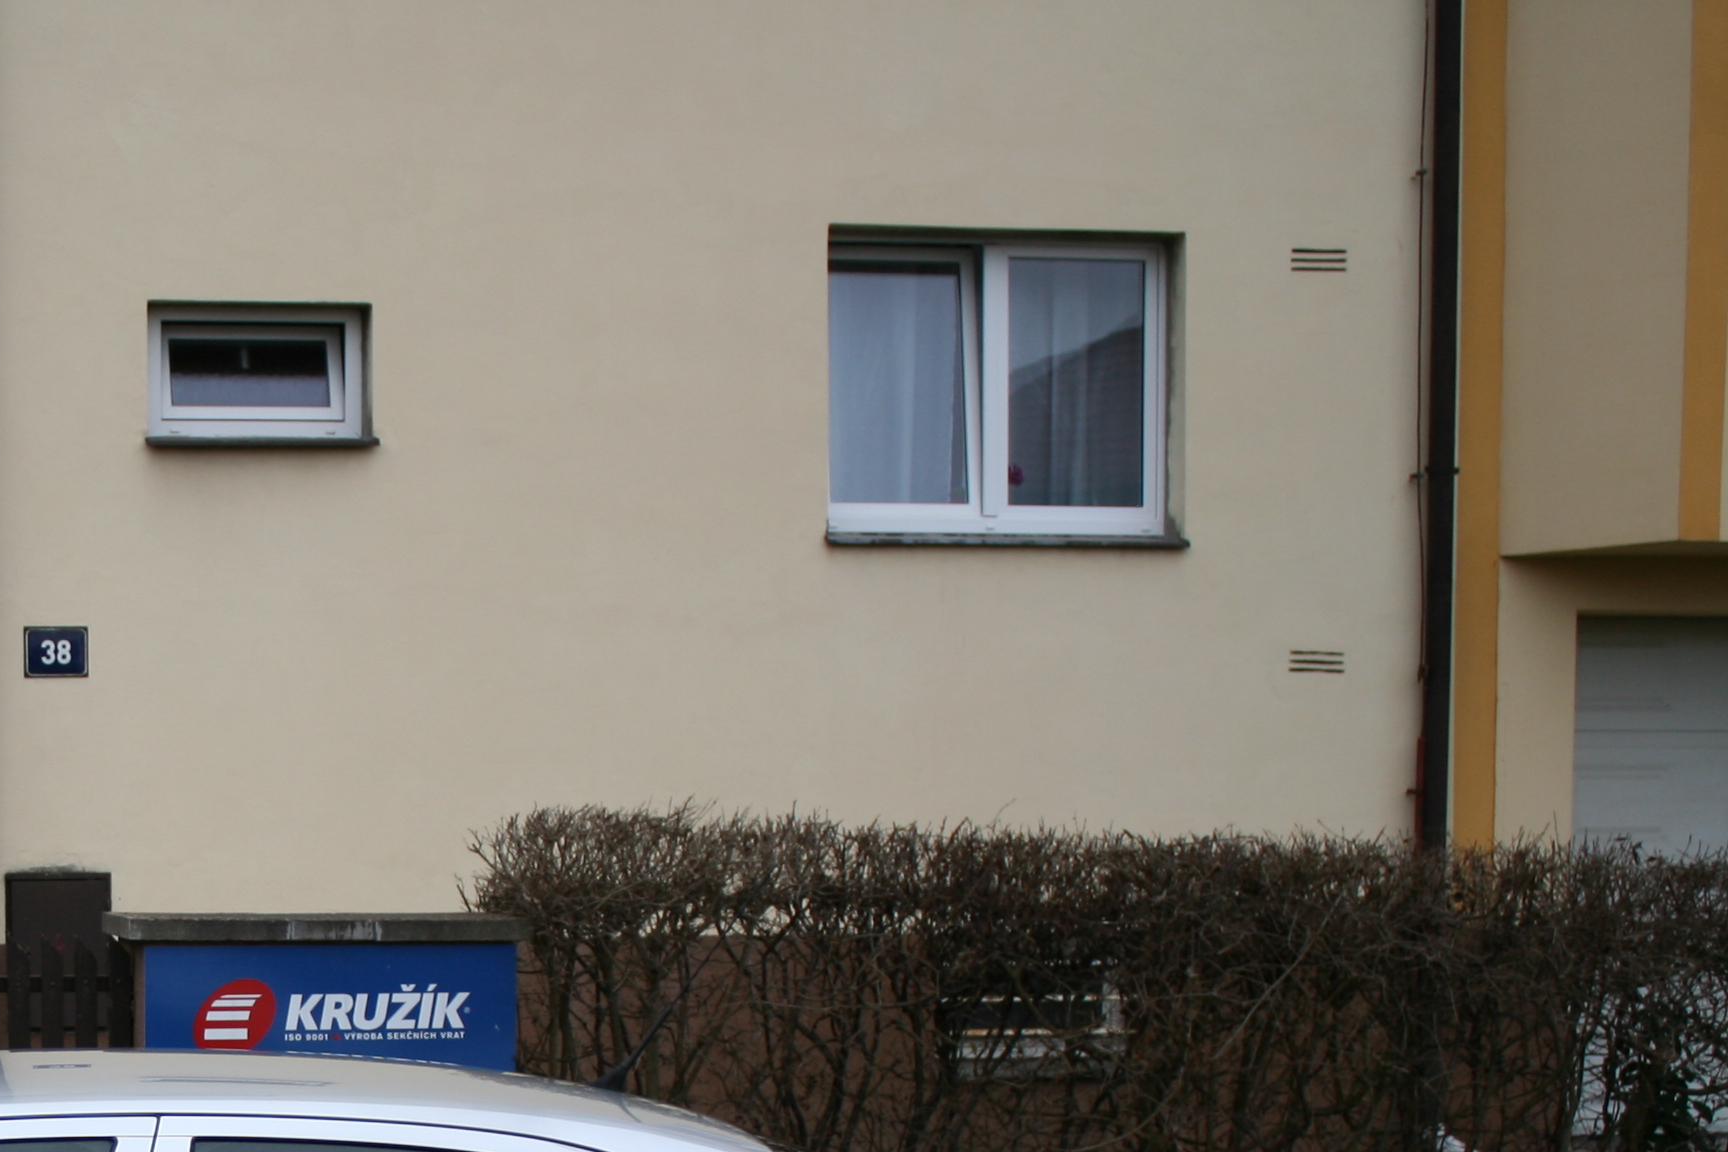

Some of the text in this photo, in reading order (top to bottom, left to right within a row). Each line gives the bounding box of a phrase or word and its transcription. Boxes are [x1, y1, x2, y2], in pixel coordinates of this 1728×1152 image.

[40, 639, 72, 665] 38
[285, 983, 471, 1031] KRUŽÍK
[284, 1030, 465, 1042] ISO 9001 VÝROBA SEKČNÍCH VRAT
